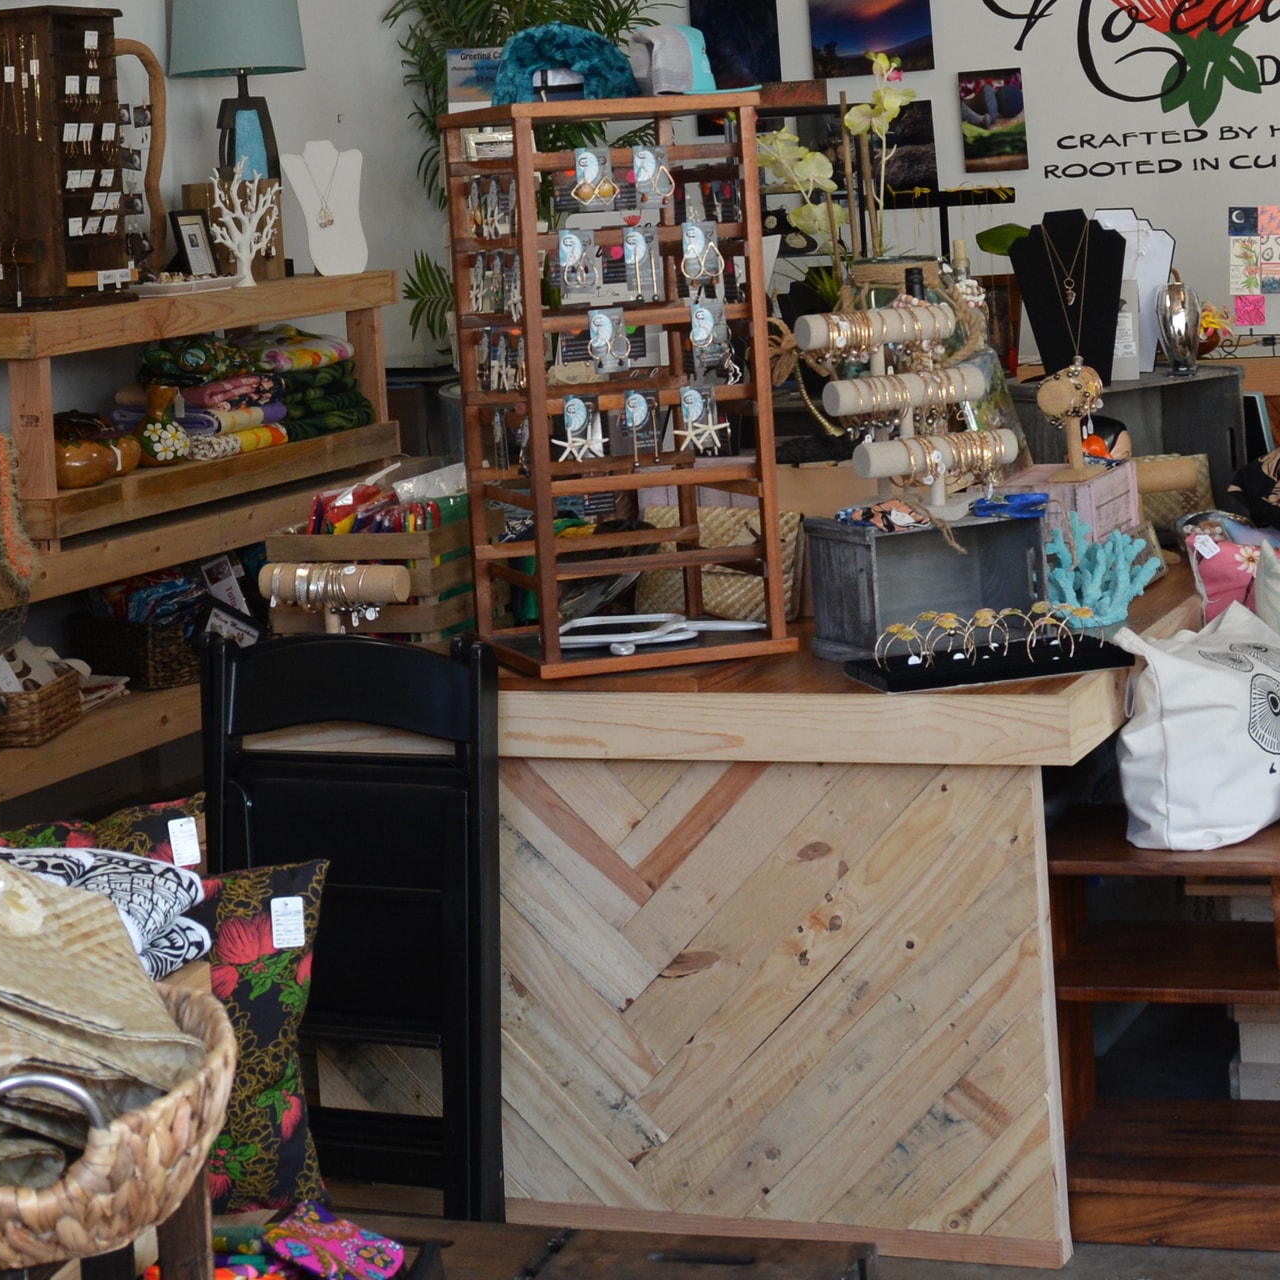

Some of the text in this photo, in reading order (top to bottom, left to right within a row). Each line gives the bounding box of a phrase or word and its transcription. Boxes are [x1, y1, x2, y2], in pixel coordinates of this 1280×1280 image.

[1055, 128, 1209, 150] CRAFTED
[1218, 125, 1259, 141] BY
[1043, 158, 1183, 180] ROOTED
[1192, 157, 1220, 172] IN
